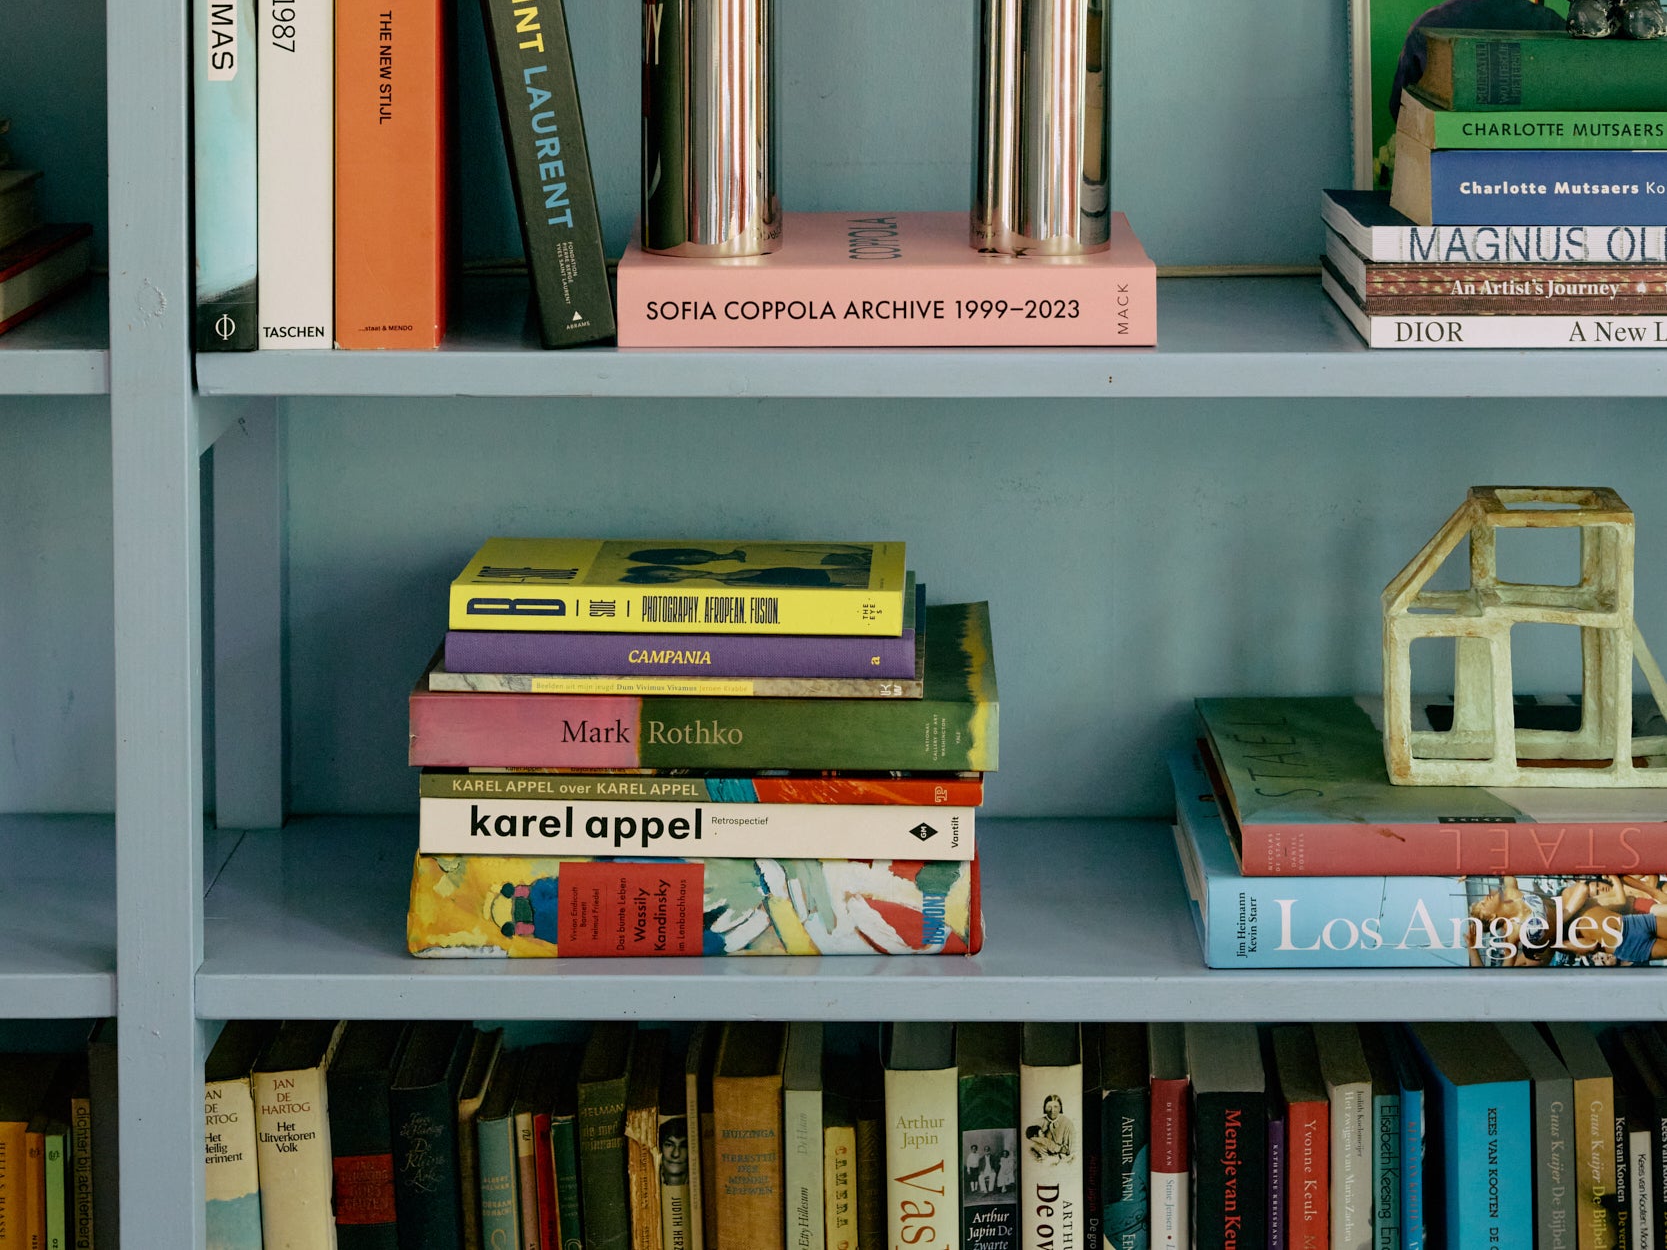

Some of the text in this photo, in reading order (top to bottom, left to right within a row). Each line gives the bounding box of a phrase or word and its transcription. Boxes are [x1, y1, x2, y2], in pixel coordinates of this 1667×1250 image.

[378, 10, 393, 126] THE NEW STIJL
[1461, 122, 1665, 138] CHARLOTTE MUTSAERS
[522, 64, 575, 230] LAURENT
[1458, 180, 1640, 196] Charlotte Mutsaers
[1408, 225, 1667, 263] MAGNUS OL
[558, 259, 566, 277] SAINT
[568, 241, 578, 277] FONDATION
[561, 278, 571, 305] LAURENT
[1450, 279, 1475, 297] An
[1543, 279, 1621, 301] Journey
[645, 300, 718, 322] SOFIA
[723, 300, 838, 321] COPPOLA
[843, 299, 946, 320] ARCHIVE
[1116, 282, 1130, 336] MACK
[262, 325, 325, 339] TASCHEN
[566, 321, 591, 330] ABRAMS
[1393, 320, 1648, 343] DIOR A New
[465, 595, 782, 625] B SIDE PHOTOGRAPHY. AFROPEAN. FUSION.
[627, 649, 713, 666] CAMPANIA
[615, 683, 698, 693] Dum Vivimus Vivamus
[560, 718, 744, 746] Mark Rothko
[451, 778, 700, 797] KAREL APPEL over KAREL APPEL
[469, 804, 703, 849] karel appel
[710, 815, 769, 827] Retrospectief
[950, 815, 960, 849] Vantilt
[616, 876, 627, 951] Das bunte Leben
[633, 887, 651, 943] Wassily
[652, 878, 671, 952] Kandinsky
[1235, 891, 1248, 959] Jim Heimann
[1247, 895, 1258, 954] Kevin Starr
[1272, 895, 1624, 961] Los Angeles
[272, 1077, 295, 1091] JAN
[261, 1101, 312, 1116] HARTOG
[895, 1114, 946, 1130] Arthur
[258, 1130, 316, 1144] Uitverkoren
[276, 1121, 296, 1132] Het
[899, 1131, 939, 1151] Japin
[275, 1142, 298, 1154] Volk
[1121, 1115, 1136, 1202] ARTHUR JAPIN
[1219, 1108, 1243, 1213] Mensje van
[1377, 1104, 1400, 1220] Elisabeth Keesing
[1546, 1101, 1566, 1208] Guus Kuijer De
[1615, 1117, 1628, 1203] Kees van Kooten
[1303, 1119, 1319, 1222] Yvonne Keuls
[1487, 1107, 1500, 1219] KEES VAN KOOTEN
[971, 1207, 1010, 1225] Arthur
[1164, 1179, 1175, 1232] Stine Jensen
